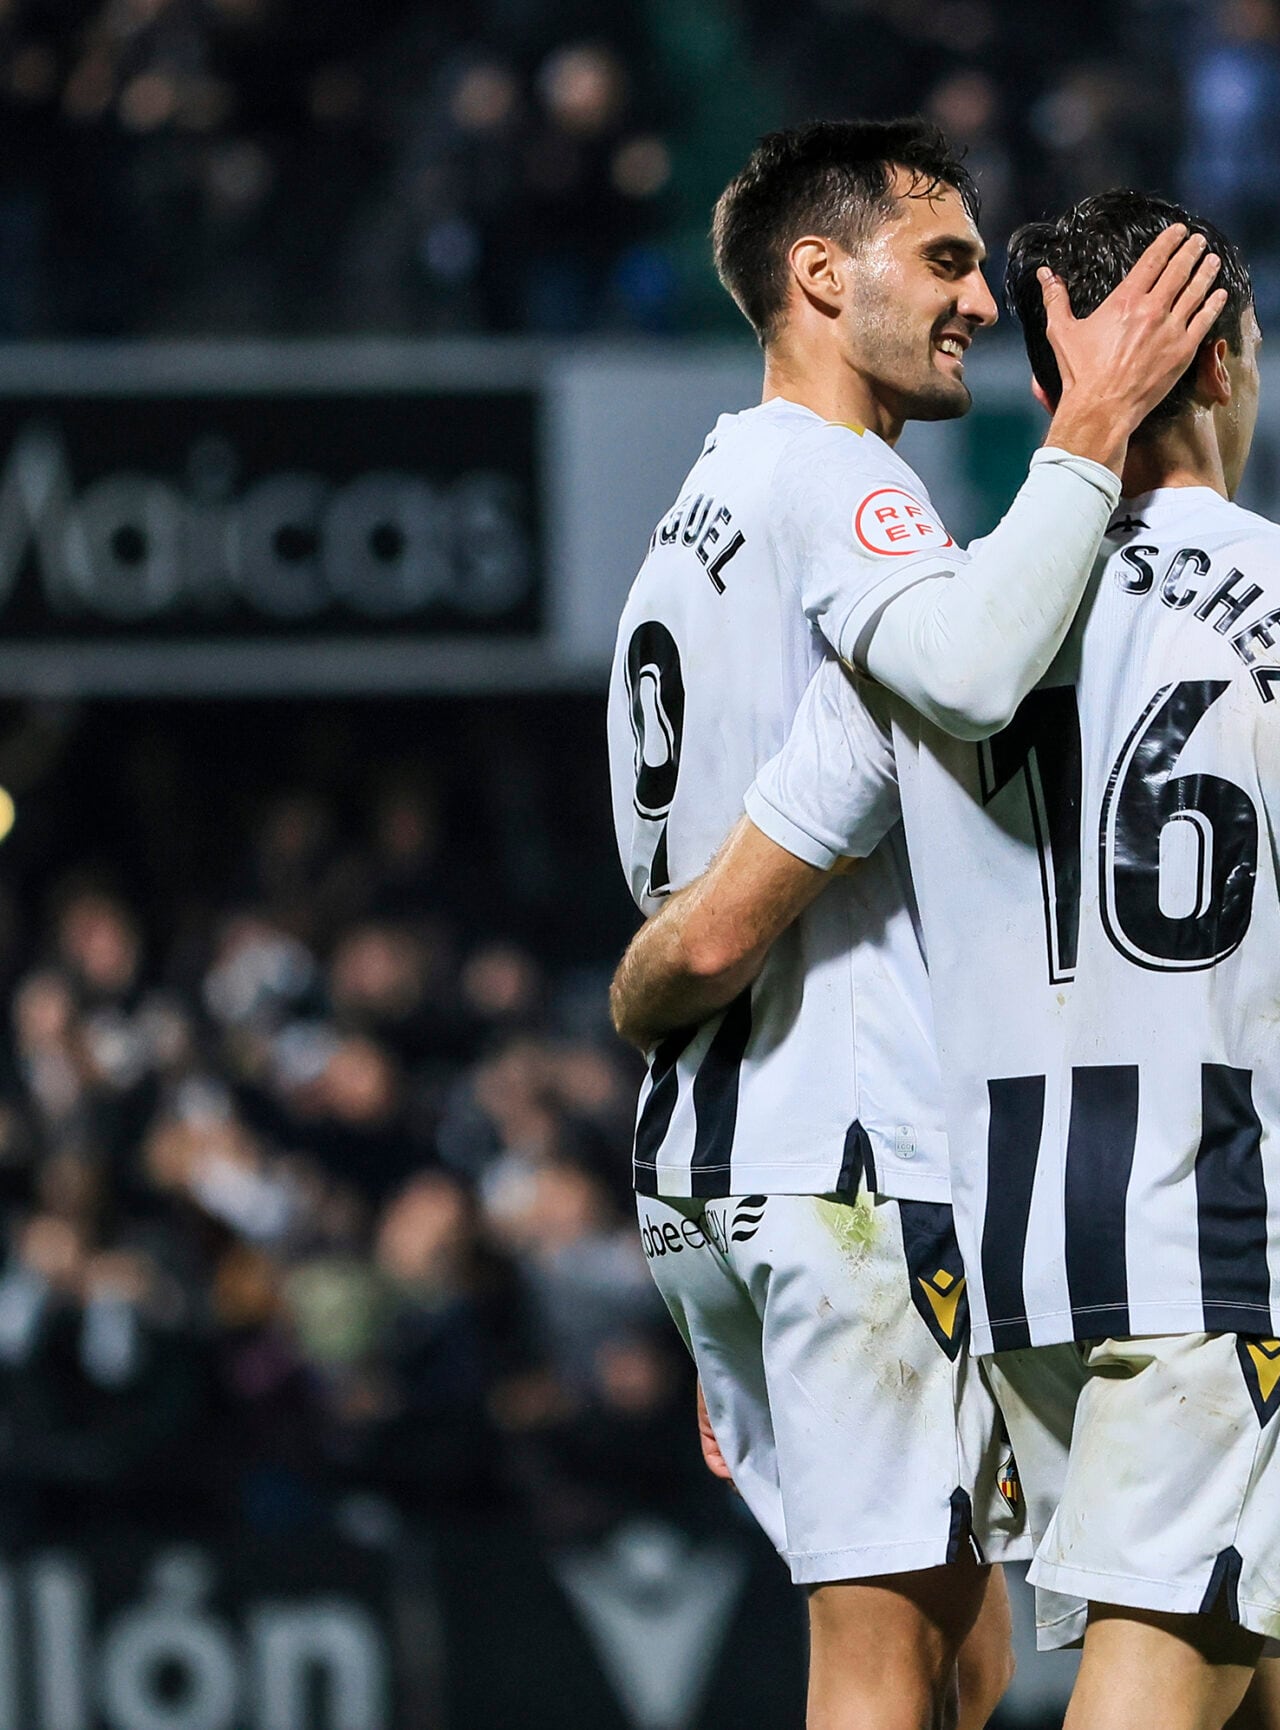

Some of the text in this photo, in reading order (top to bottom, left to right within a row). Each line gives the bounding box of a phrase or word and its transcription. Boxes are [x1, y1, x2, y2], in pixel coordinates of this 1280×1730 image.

[651, 493, 746, 595] GUEL
[976, 680, 1259, 986] 16
[0, 1545, 388, 1730] lón
